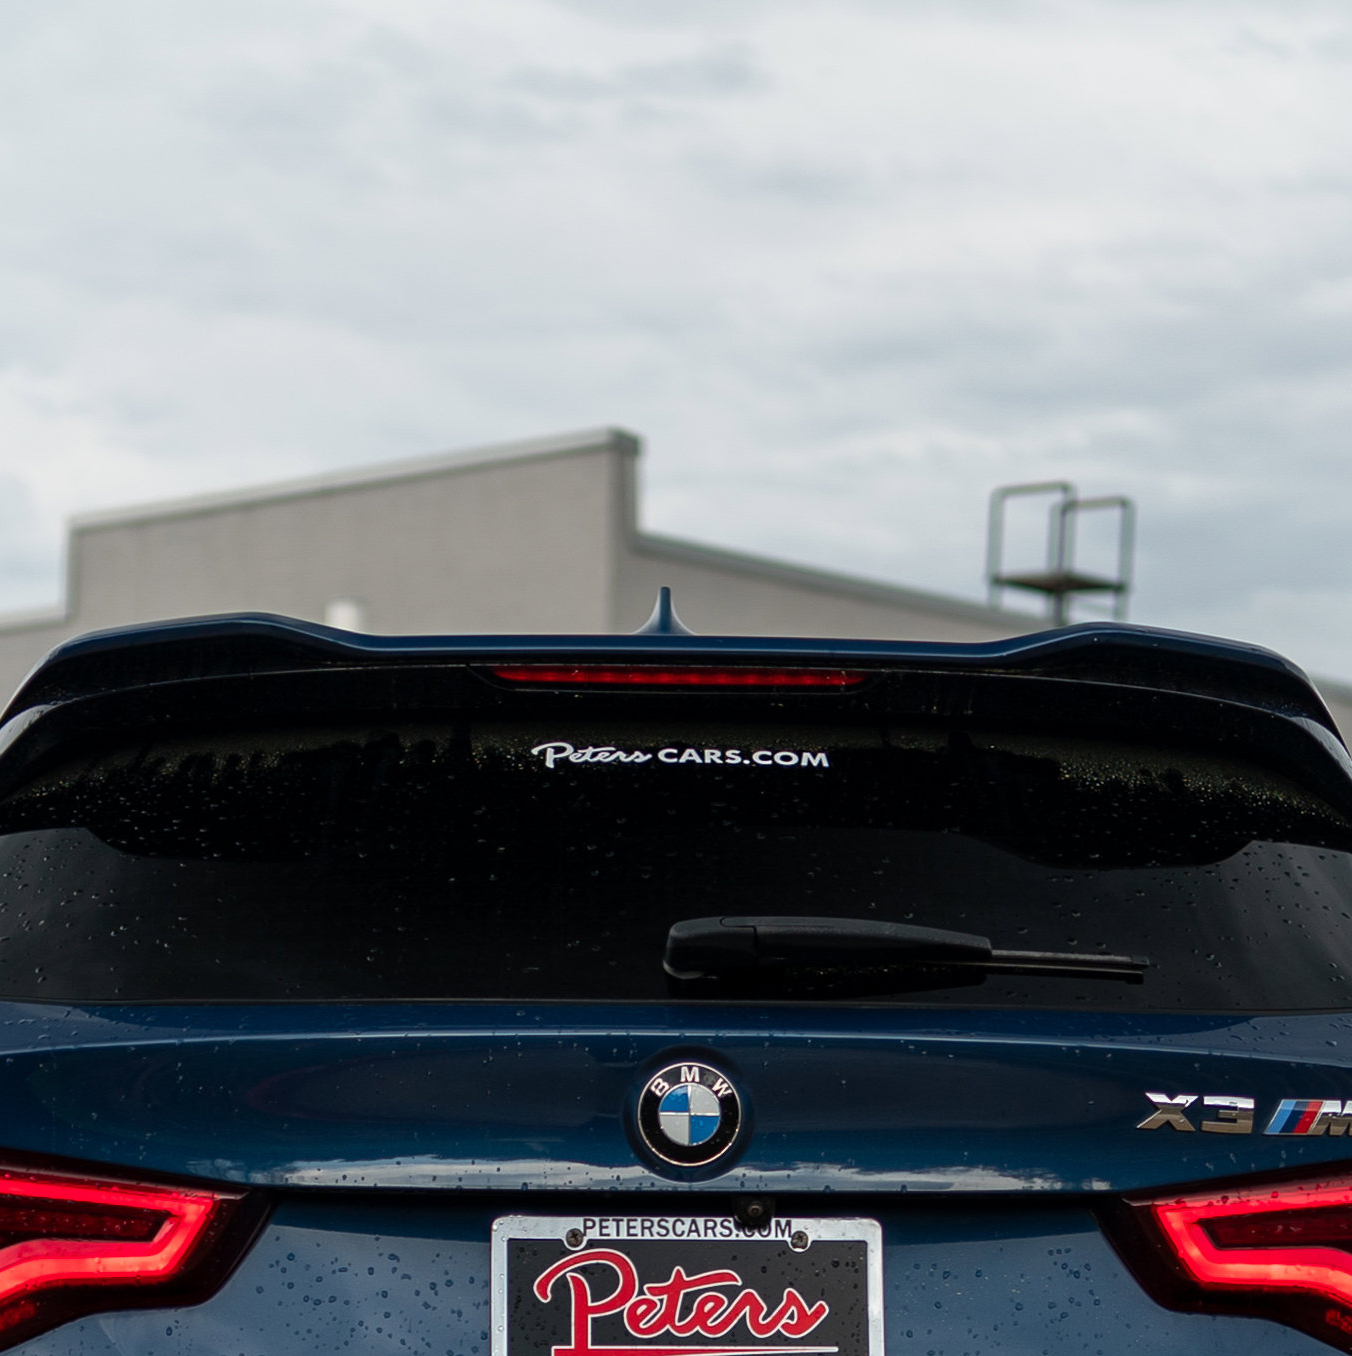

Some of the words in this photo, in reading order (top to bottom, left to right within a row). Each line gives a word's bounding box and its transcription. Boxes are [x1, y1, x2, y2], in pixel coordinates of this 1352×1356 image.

[531, 741, 653, 769] Peters
[657, 748, 830, 768] CARS.COM
[650, 1066, 733, 1098] BMW
[1136, 1092, 1255, 1133] X3
[533, 1248, 829, 1349] Peters
